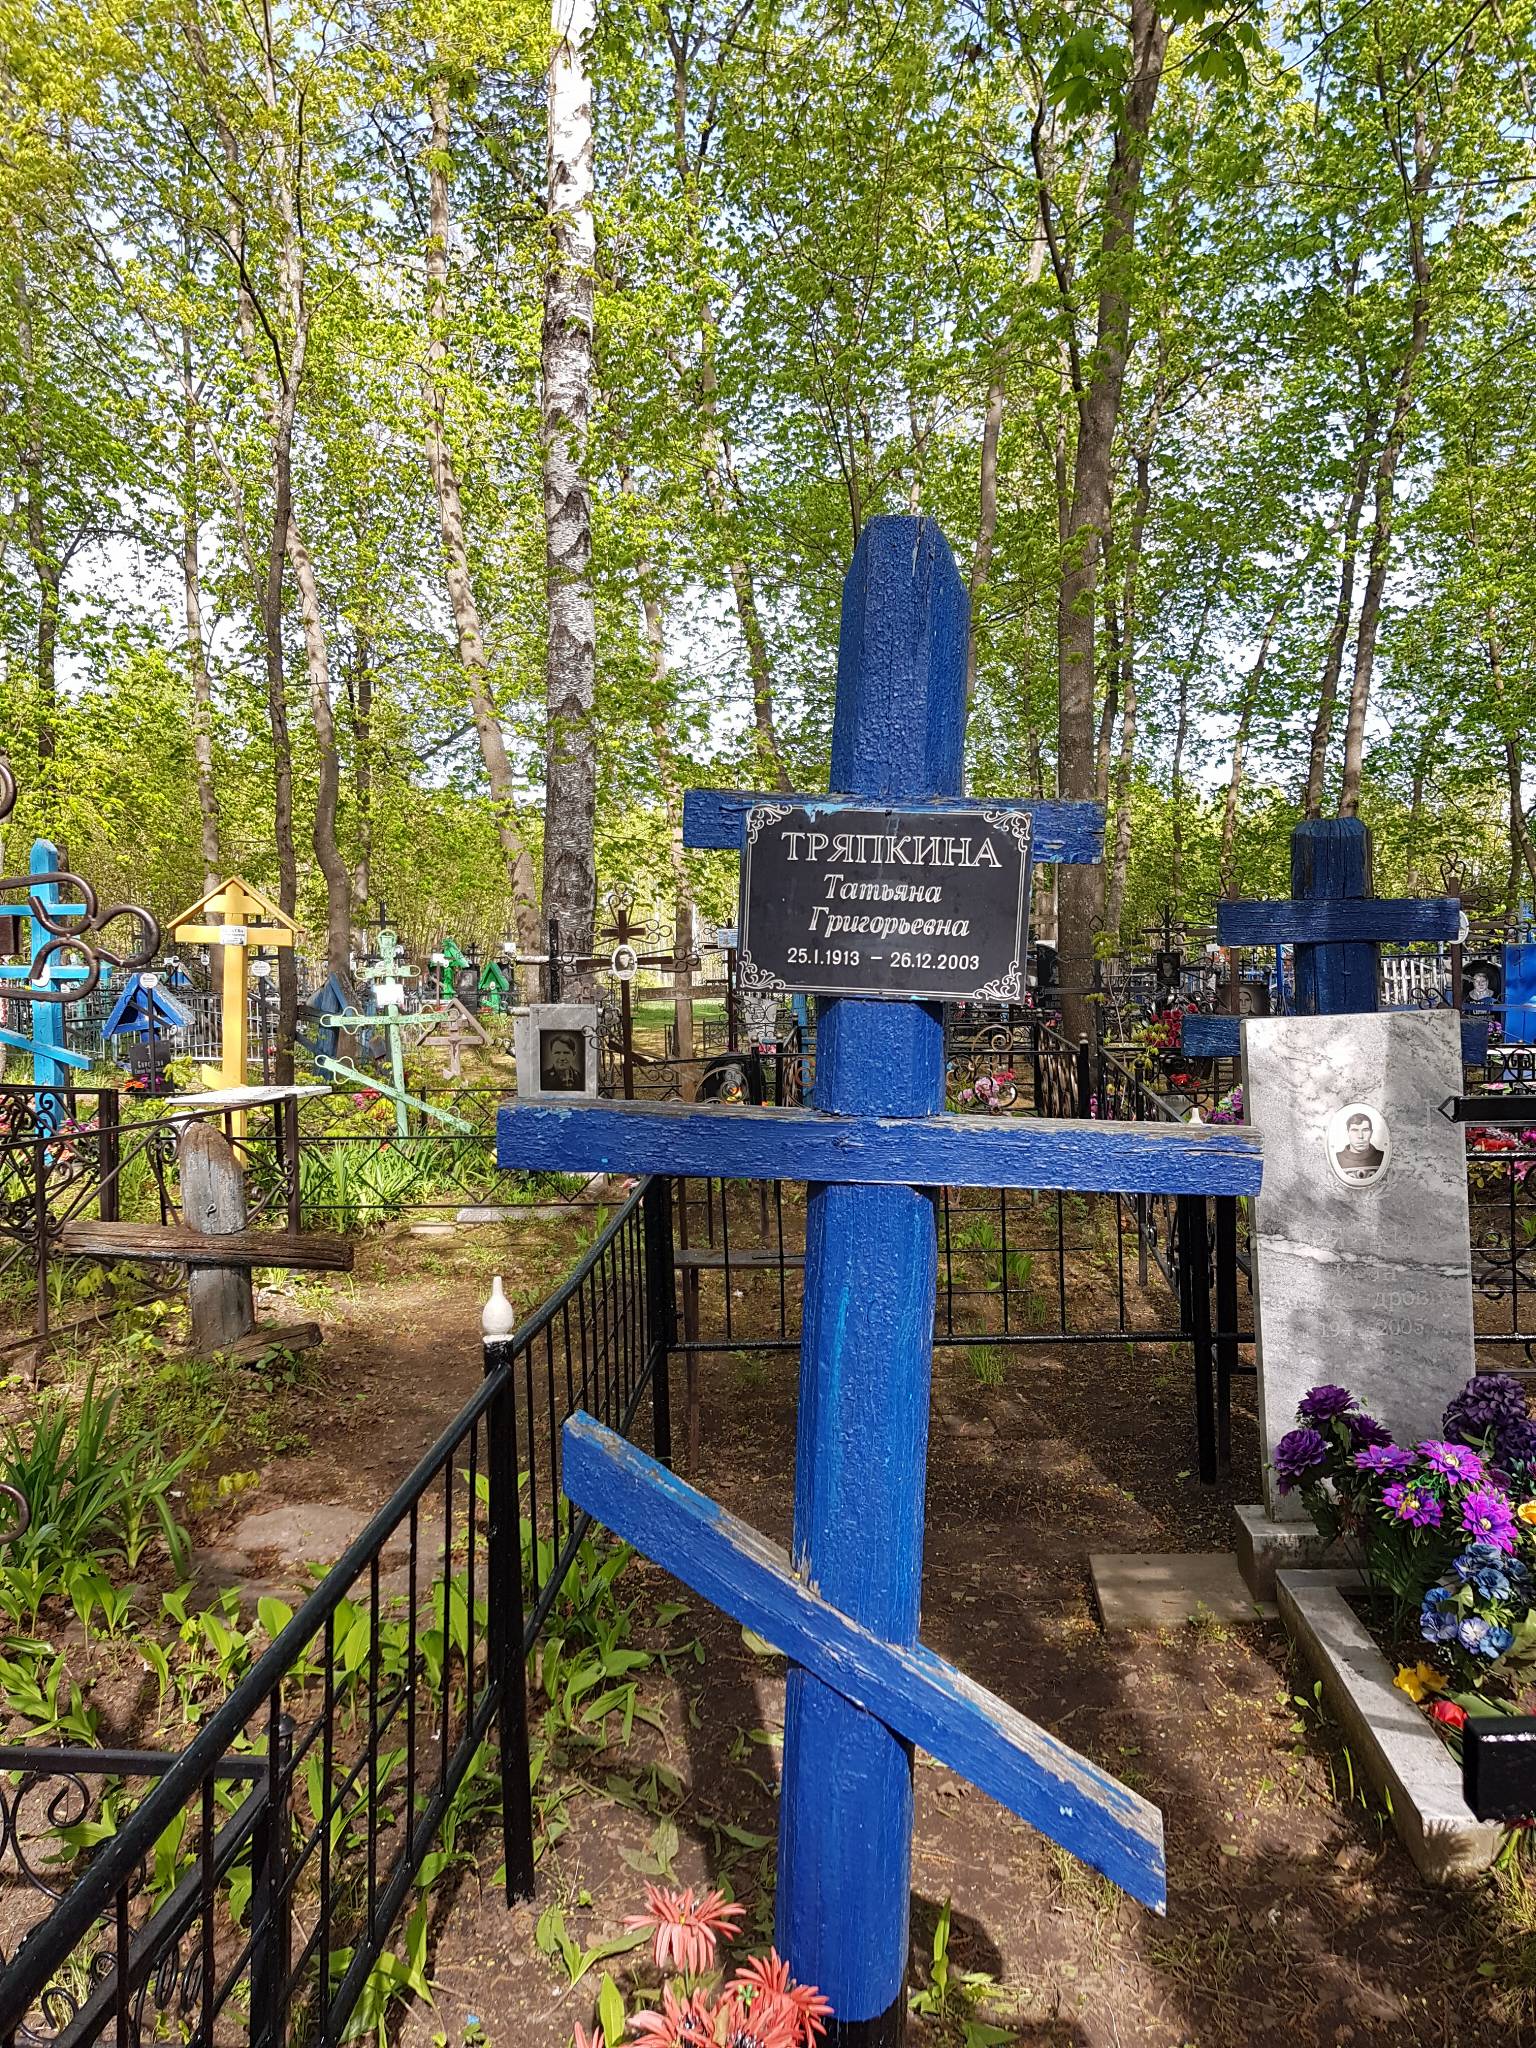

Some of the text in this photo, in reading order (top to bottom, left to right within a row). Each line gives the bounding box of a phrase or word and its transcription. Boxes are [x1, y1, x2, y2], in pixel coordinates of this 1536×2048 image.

[781, 832, 1003, 868] ТРЯПКИНА
[824, 873, 943, 903] Татьяна
[808, 906, 970, 939] Григорьевна
[889, 952, 980, 970] 26.12.2003
